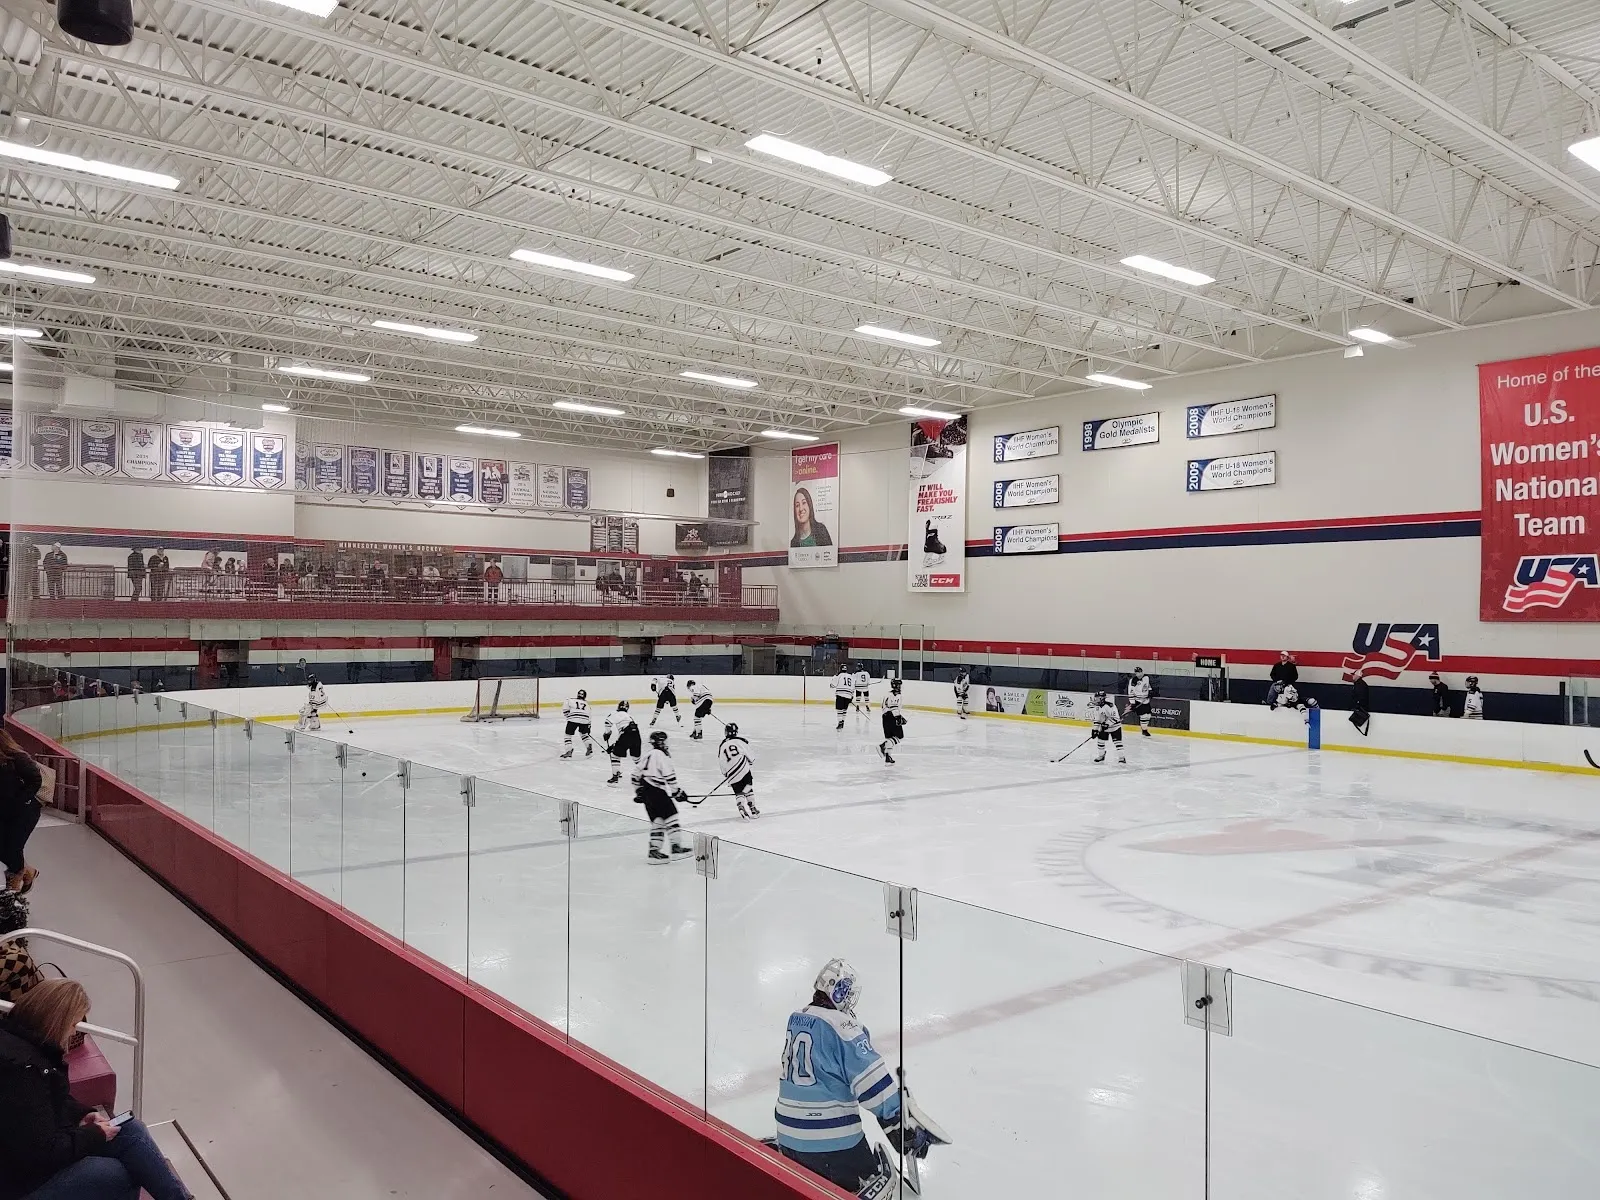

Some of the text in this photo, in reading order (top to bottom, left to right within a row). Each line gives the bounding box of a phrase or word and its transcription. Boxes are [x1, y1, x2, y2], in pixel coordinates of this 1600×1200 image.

[1497, 364, 1600, 389] Home of the
[1241, 402, 1274, 412] Women's
[1212, 410, 1272, 424] World Champions
[1524, 399, 1576, 427] U.S.
[1111, 418, 1144, 429] Olympic
[1189, 408, 1198, 436] 2008
[1084, 423, 1092, 449] 1998
[1099, 425, 1156, 439] Gold Medalists
[1241, 458, 1274, 468] Women's
[1189, 462, 1198, 489] 2009
[1211, 467, 1272, 478] World Champions
[927, 483, 943, 491] WILL
[1025, 480, 1052, 488] Women's
[1495, 474, 1600, 502] Nationa
[918, 491, 938, 499] MAKE
[995, 483, 1003, 507] 2008
[1025, 487, 1058, 496] Champions
[917, 496, 958, 506] FREAKISHLY
[1514, 513, 1585, 537] Team
[1025, 527, 1052, 535] Women's
[1024, 535, 1058, 544] Champions
[1503, 555, 1600, 612] USA
[1343, 622, 1441, 681] USA
[1200, 658, 1217, 667] HOME
[843, 676, 852, 687] 16
[860, 674, 867, 683] 9
[575, 701, 587, 710] 17
[723, 744, 740, 762] 19
[864, 1176, 888, 1199] CCM
